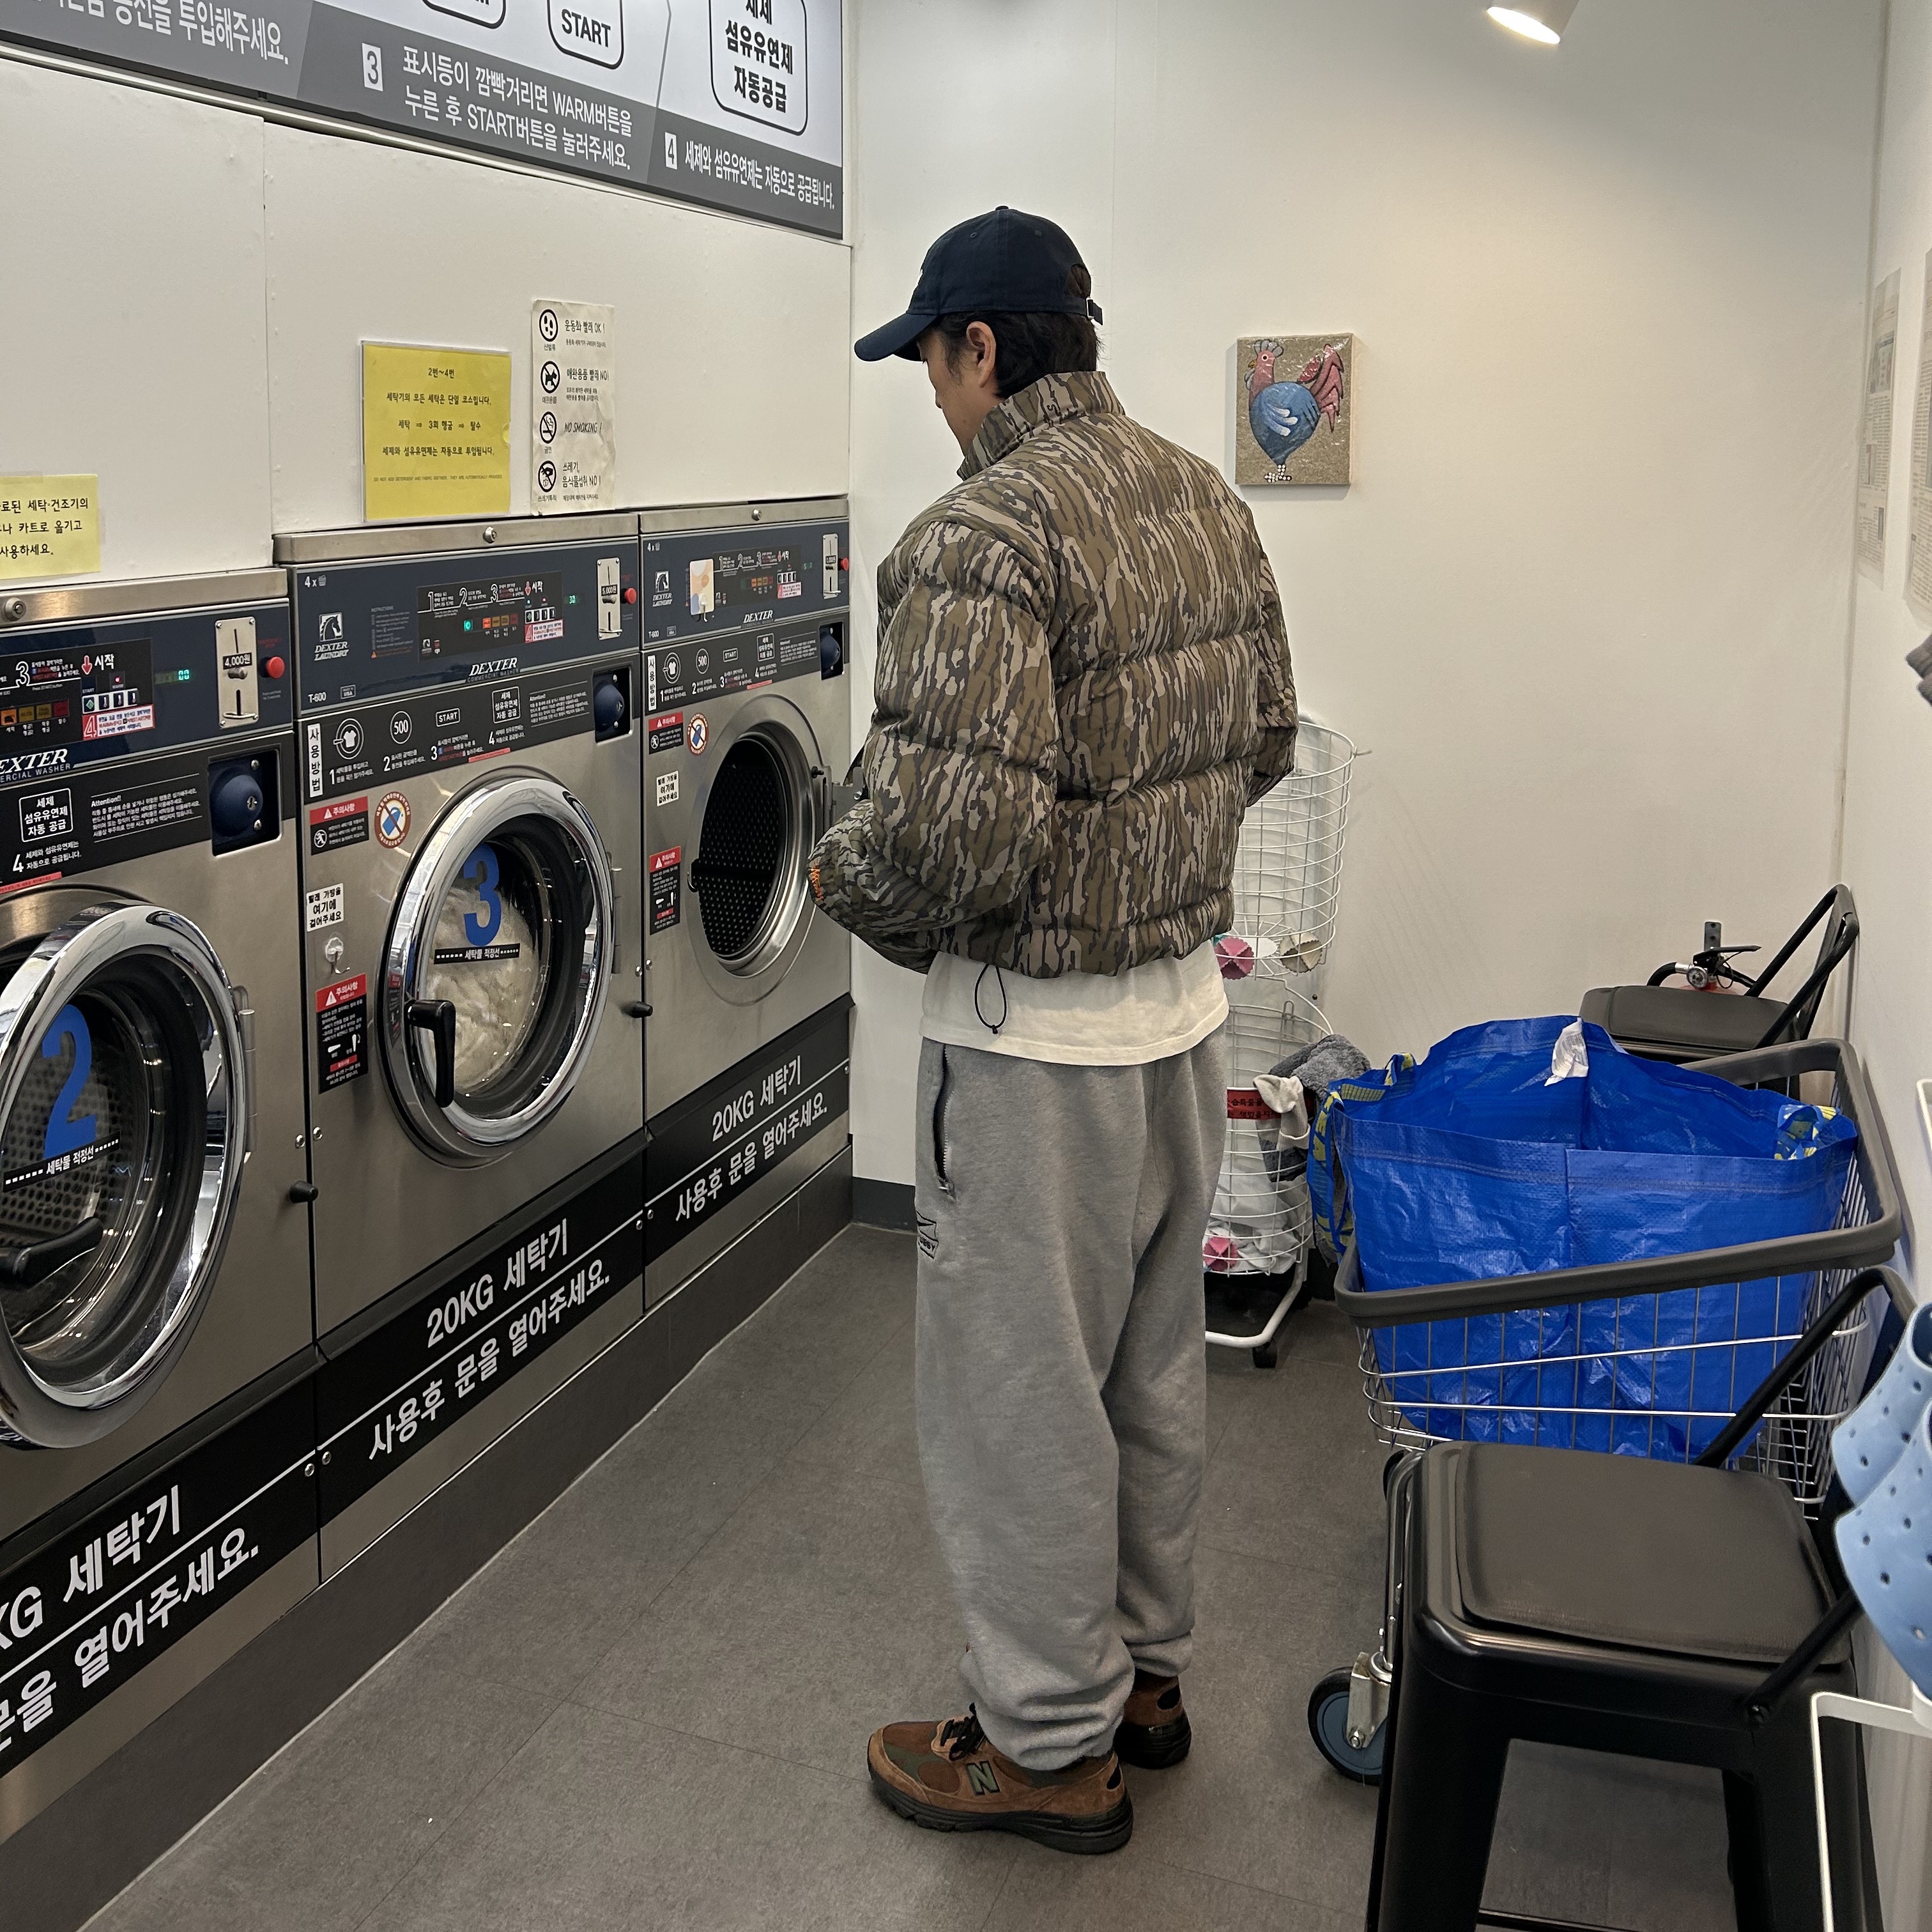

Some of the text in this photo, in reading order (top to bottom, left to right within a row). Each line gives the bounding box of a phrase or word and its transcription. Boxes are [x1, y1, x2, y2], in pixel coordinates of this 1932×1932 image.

[745, 0, 772, 25] 세제
[179, 0, 289, 65] 투입해주세요.
[561, 8, 611, 48] START
[724, 19, 793, 75] 섬유유연제
[367, 50, 379, 84] 3
[403, 45, 632, 137] 표시등이 깜빡거리면 WARM버튼을
[733, 65, 787, 114] 자동공급
[405, 85, 631, 171] 누른 후 START버튼을 눌러주세요.
[668, 138, 675, 165] 4
[685, 140, 835, 210] 세제와 섬유유연제는 자동으로 공급됩니다.
[565, 319, 582, 332] 운동화
[583, 321, 594, 334] 빨래
[589, 369, 599, 381] 빨래
[387, 392, 410, 402] 세탁기의
[413, 394, 425, 404] 모든
[428, 394, 445, 405] 세탁은
[398, 420, 411, 431] 세탁
[429, 420, 439, 429] 3회
[564, 422, 598, 433] NO SMOKING
[383, 447, 401, 456] 세제와
[404, 446, 438, 457] 섬유유연제는
[441, 446, 463, 457] 자동으로
[589, 475, 597, 486] NO
[0, 500, 21, 514] 료된
[19, 521, 49, 534] 카트로
[54, 519, 82, 534] 옮기고
[0, 543, 54, 560] 사용하세요.
[532, 581, 543, 593] 시작
[743, 610, 773, 624] DEXTER
[314, 641, 348, 653] DEXTER
[314, 649, 349, 661] LAUNDRY
[724, 651, 737, 659] START
[95, 654, 114, 671] 시작
[224, 654, 251, 668] 4,000원
[469, 657, 518, 677] DEXTER
[698, 655, 707, 667] 500
[16, 661, 30, 687] 3
[755, 667, 759, 678] 4
[692, 682, 697, 694] 2
[720, 676, 724, 688] 3
[308, 691, 327, 703] T-600
[660, 690, 664, 702] 1
[439, 712, 457, 723] START
[84, 715, 97, 739] 4
[394, 719, 409, 735] 500
[488, 731, 495, 745] 4
[431, 746, 438, 760] 3
[35, 763, 71, 776] WASHER
[383, 756, 391, 772] 2
[330, 769, 335, 785] 1
[36, 795, 54, 808] 세제
[333, 802, 355, 815] 주의사항
[24, 806, 68, 825] 섬유유연제
[28, 818, 66, 836] 자동 공급
[26, 849, 43, 859] 세제와
[12, 854, 24, 873] 4
[26, 858, 50, 870] 자동으로
[308, 887, 341, 903] 빨래 가방을
[463, 843, 502, 946] 3
[313, 898, 337, 915] 여기에
[309, 911, 342, 928] 걸어주세요
[464, 949, 483, 960] 세탁물
[42, 1004, 96, 1159] 2
[712, 1055, 801, 1142] 20KG 세탁기
[46, 1145, 94, 1175] 세탁물 적정선
[675, 1092, 827, 1222] 사용후 문을 열어주세요.
[427, 1218, 567, 1348] 20KG 세탁기
[369, 1259, 610, 1460] 사용후 문을 열어주세요.
[63, 1485, 180, 1602] 세탁기
[75, 1528, 259, 1689] 열어주세요.
[967, 1761, 1000, 1796] N
